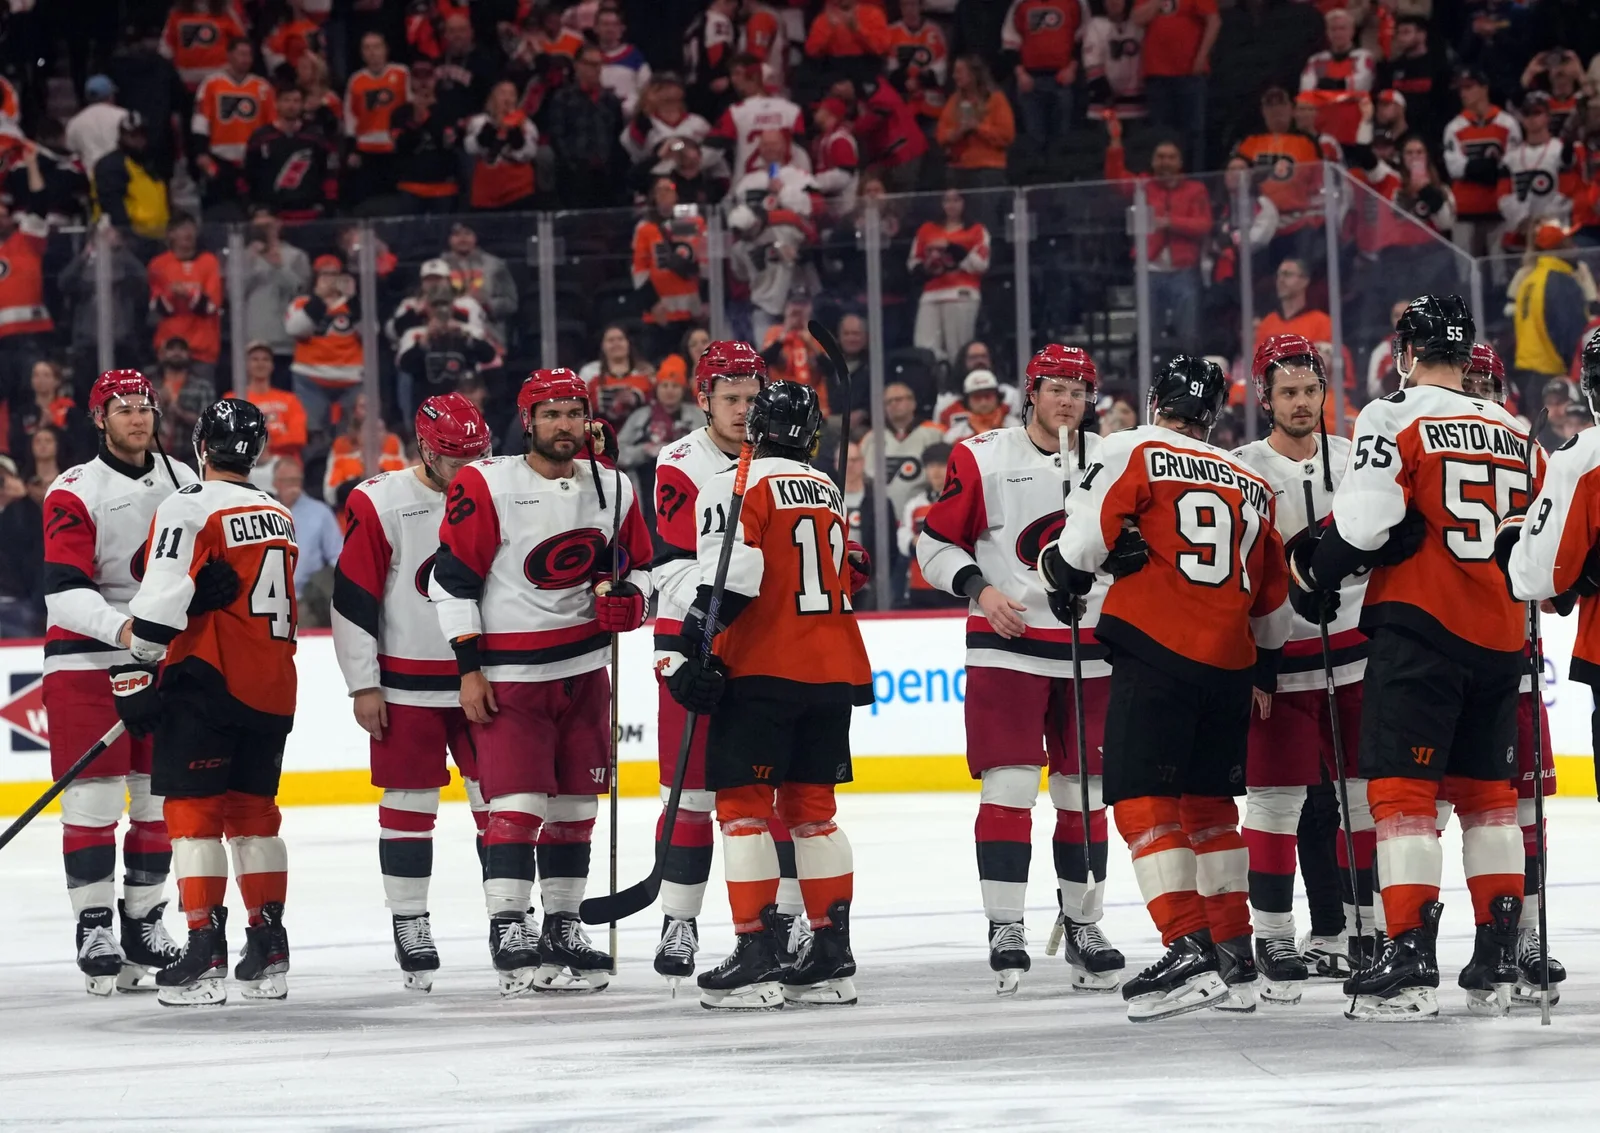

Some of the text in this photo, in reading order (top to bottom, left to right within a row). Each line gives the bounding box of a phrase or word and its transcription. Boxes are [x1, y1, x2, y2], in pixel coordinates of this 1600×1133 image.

[1446, 326, 1464, 342] 55
[734, 343, 747, 351] 21
[1189, 381, 1205, 398] 91
[422, 405, 438, 419] Lenovo
[788, 425, 801, 438] 11
[234, 440, 249, 455] 41
[463, 440, 483, 449] CCM
[1354, 435, 1396, 471] 55
[448, 484, 476, 525] 28
[658, 484, 688, 523] 21
[776, 480, 845, 517] KONECNY
[46, 507, 83, 540] 77
[701, 503, 726, 537] 11
[154, 527, 184, 560] 41
[84, 911, 108, 919] CCM
